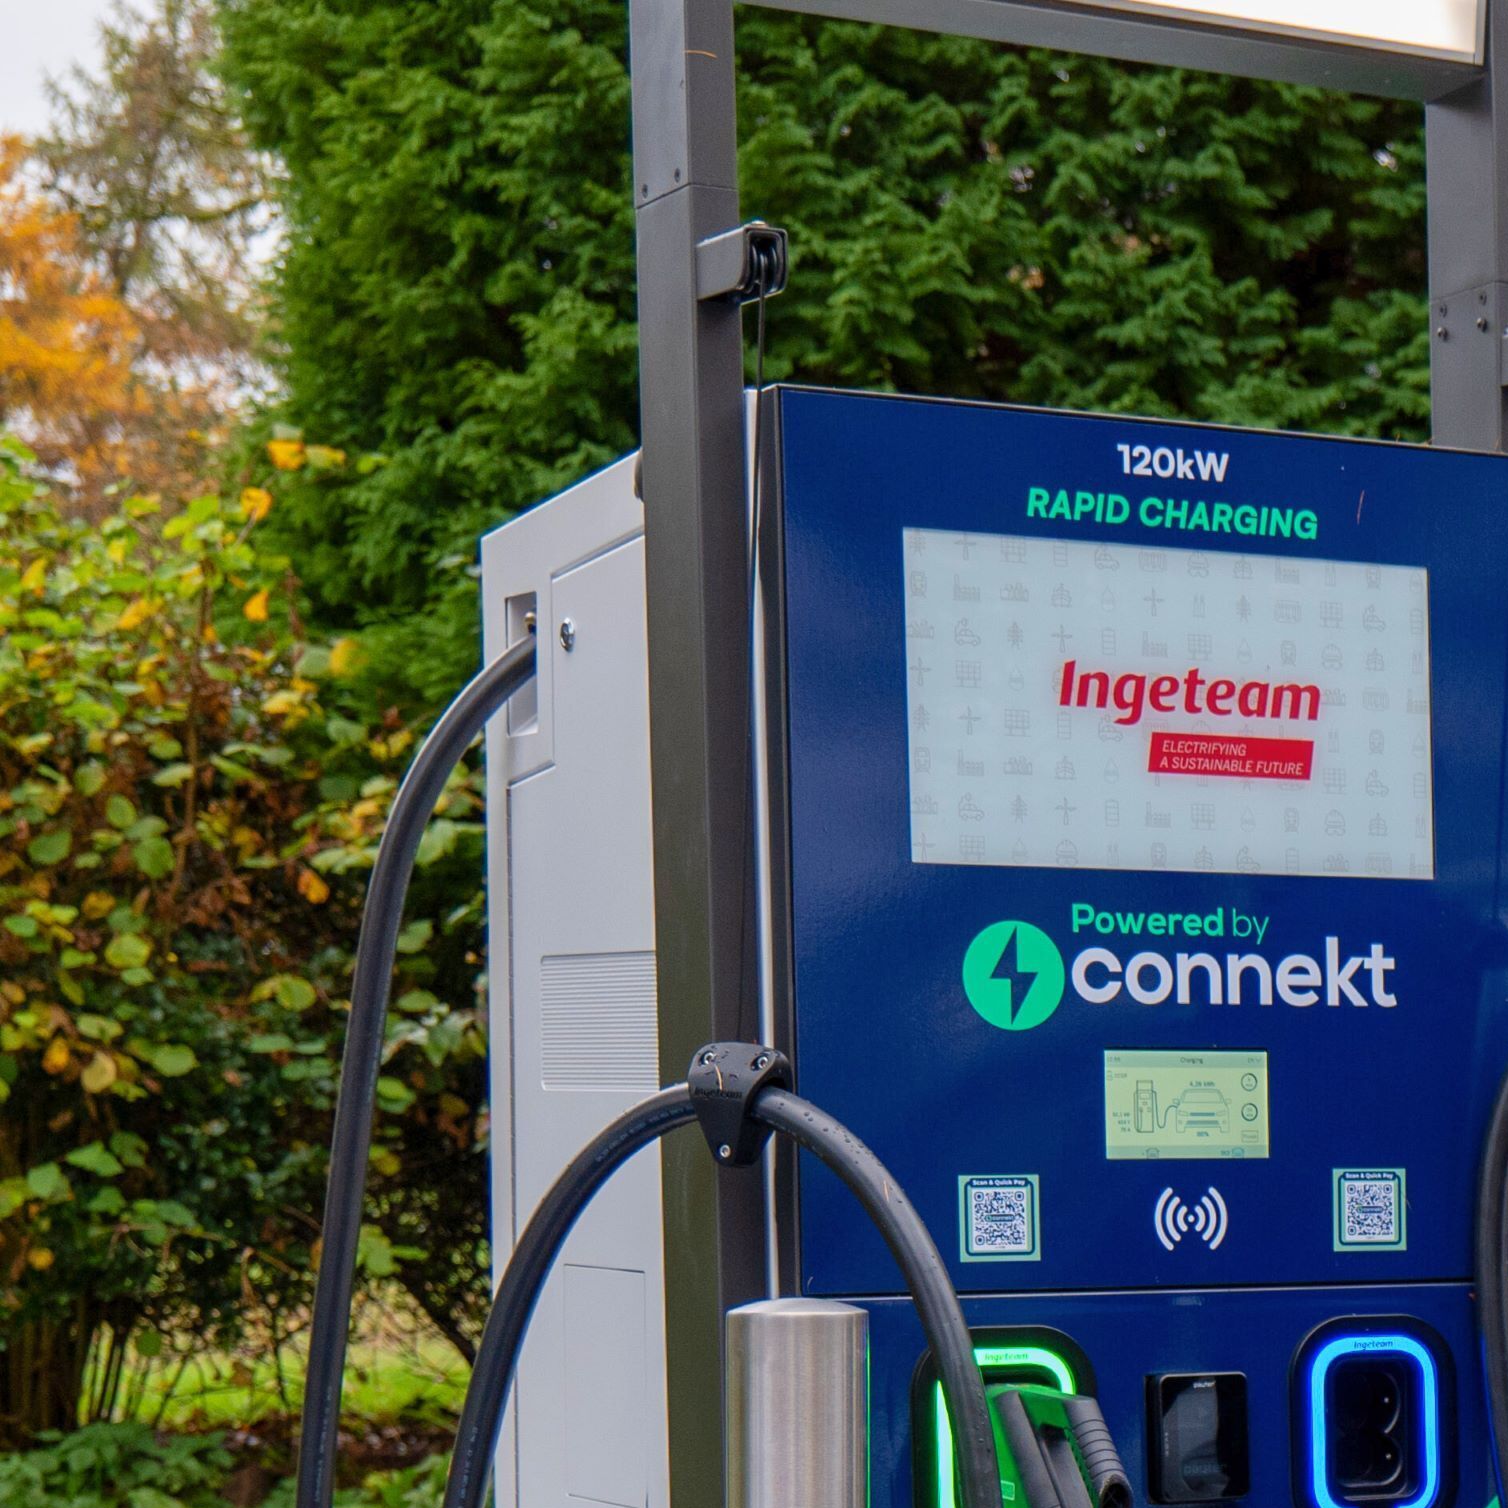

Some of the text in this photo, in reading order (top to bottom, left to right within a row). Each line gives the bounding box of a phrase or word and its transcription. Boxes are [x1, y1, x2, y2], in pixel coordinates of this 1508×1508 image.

[1116, 443, 1229, 482] 120kW
[1026, 486, 1318, 540] RAPID CHARGING
[1059, 660, 1320, 725] Ingeteam
[1159, 756, 1304, 775] A SUSTAINABLE FUTURE
[1162, 740, 1247, 757] ELECTRIFYING
[1072, 903, 1269, 945] Powered by
[1072, 936, 1397, 1008] connekt
